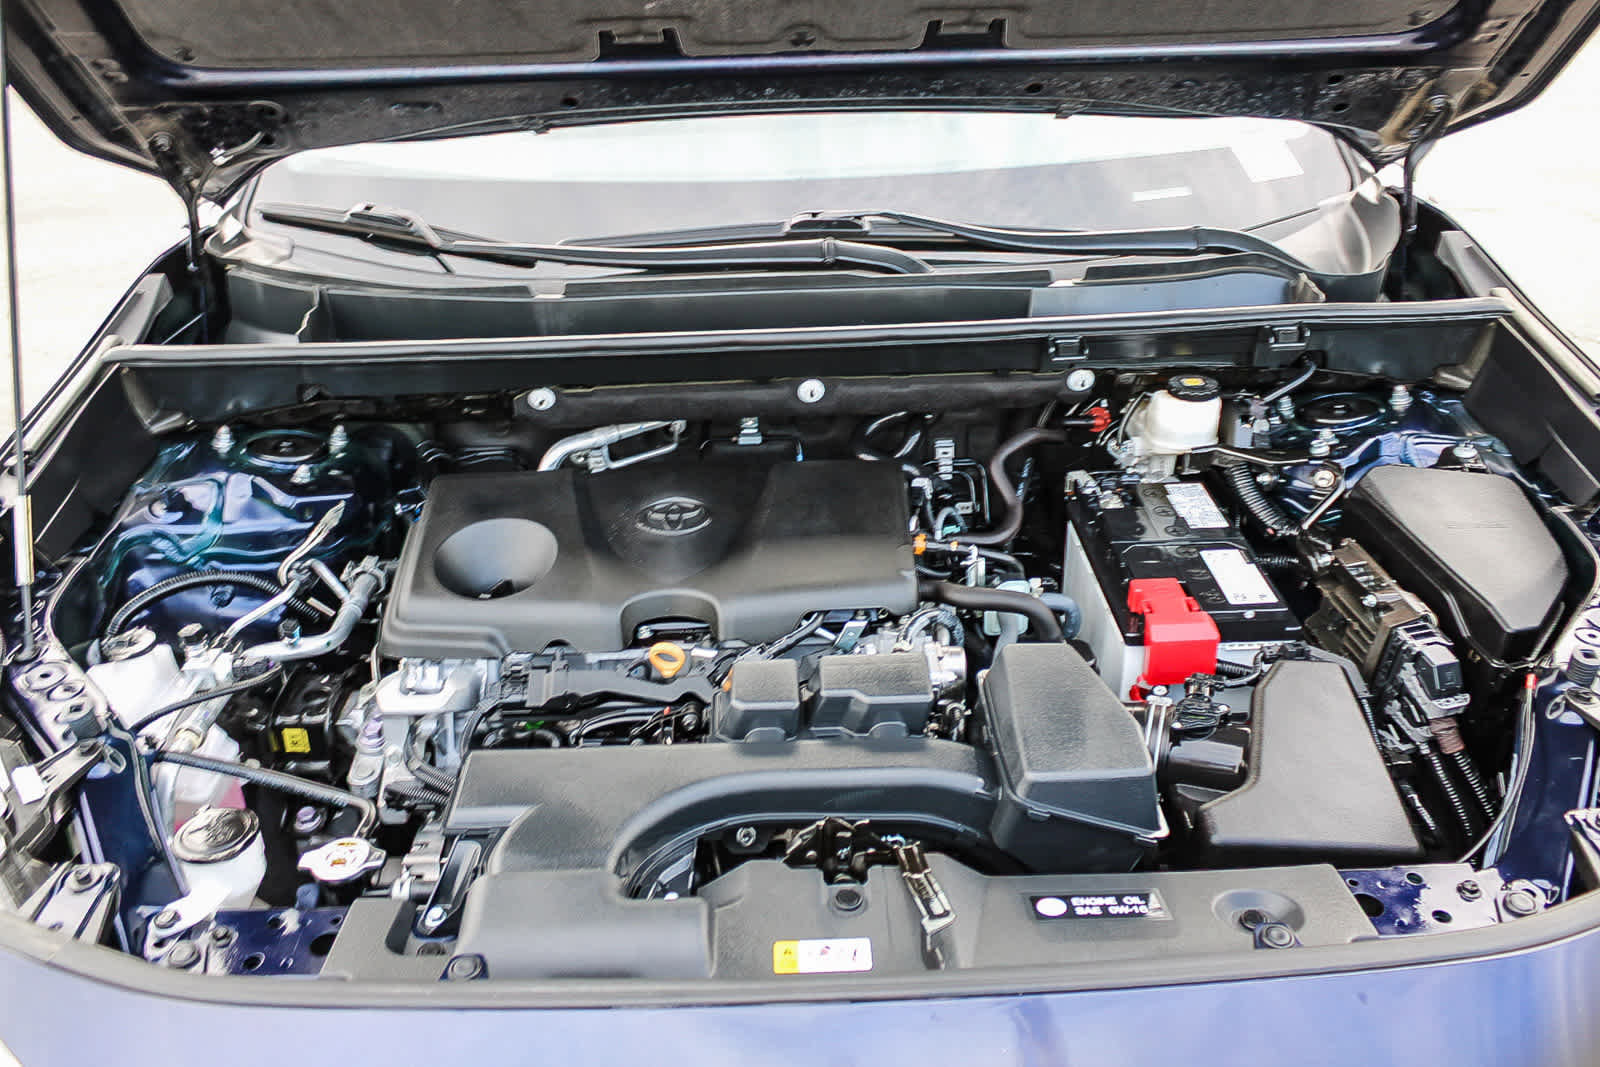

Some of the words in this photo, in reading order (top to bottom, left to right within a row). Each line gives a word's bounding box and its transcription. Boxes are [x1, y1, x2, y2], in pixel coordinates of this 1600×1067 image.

[1070, 896, 1118, 906] ENGINE
[1122, 895, 1146, 905] OIL
[1074, 906, 1103, 916] SAE
